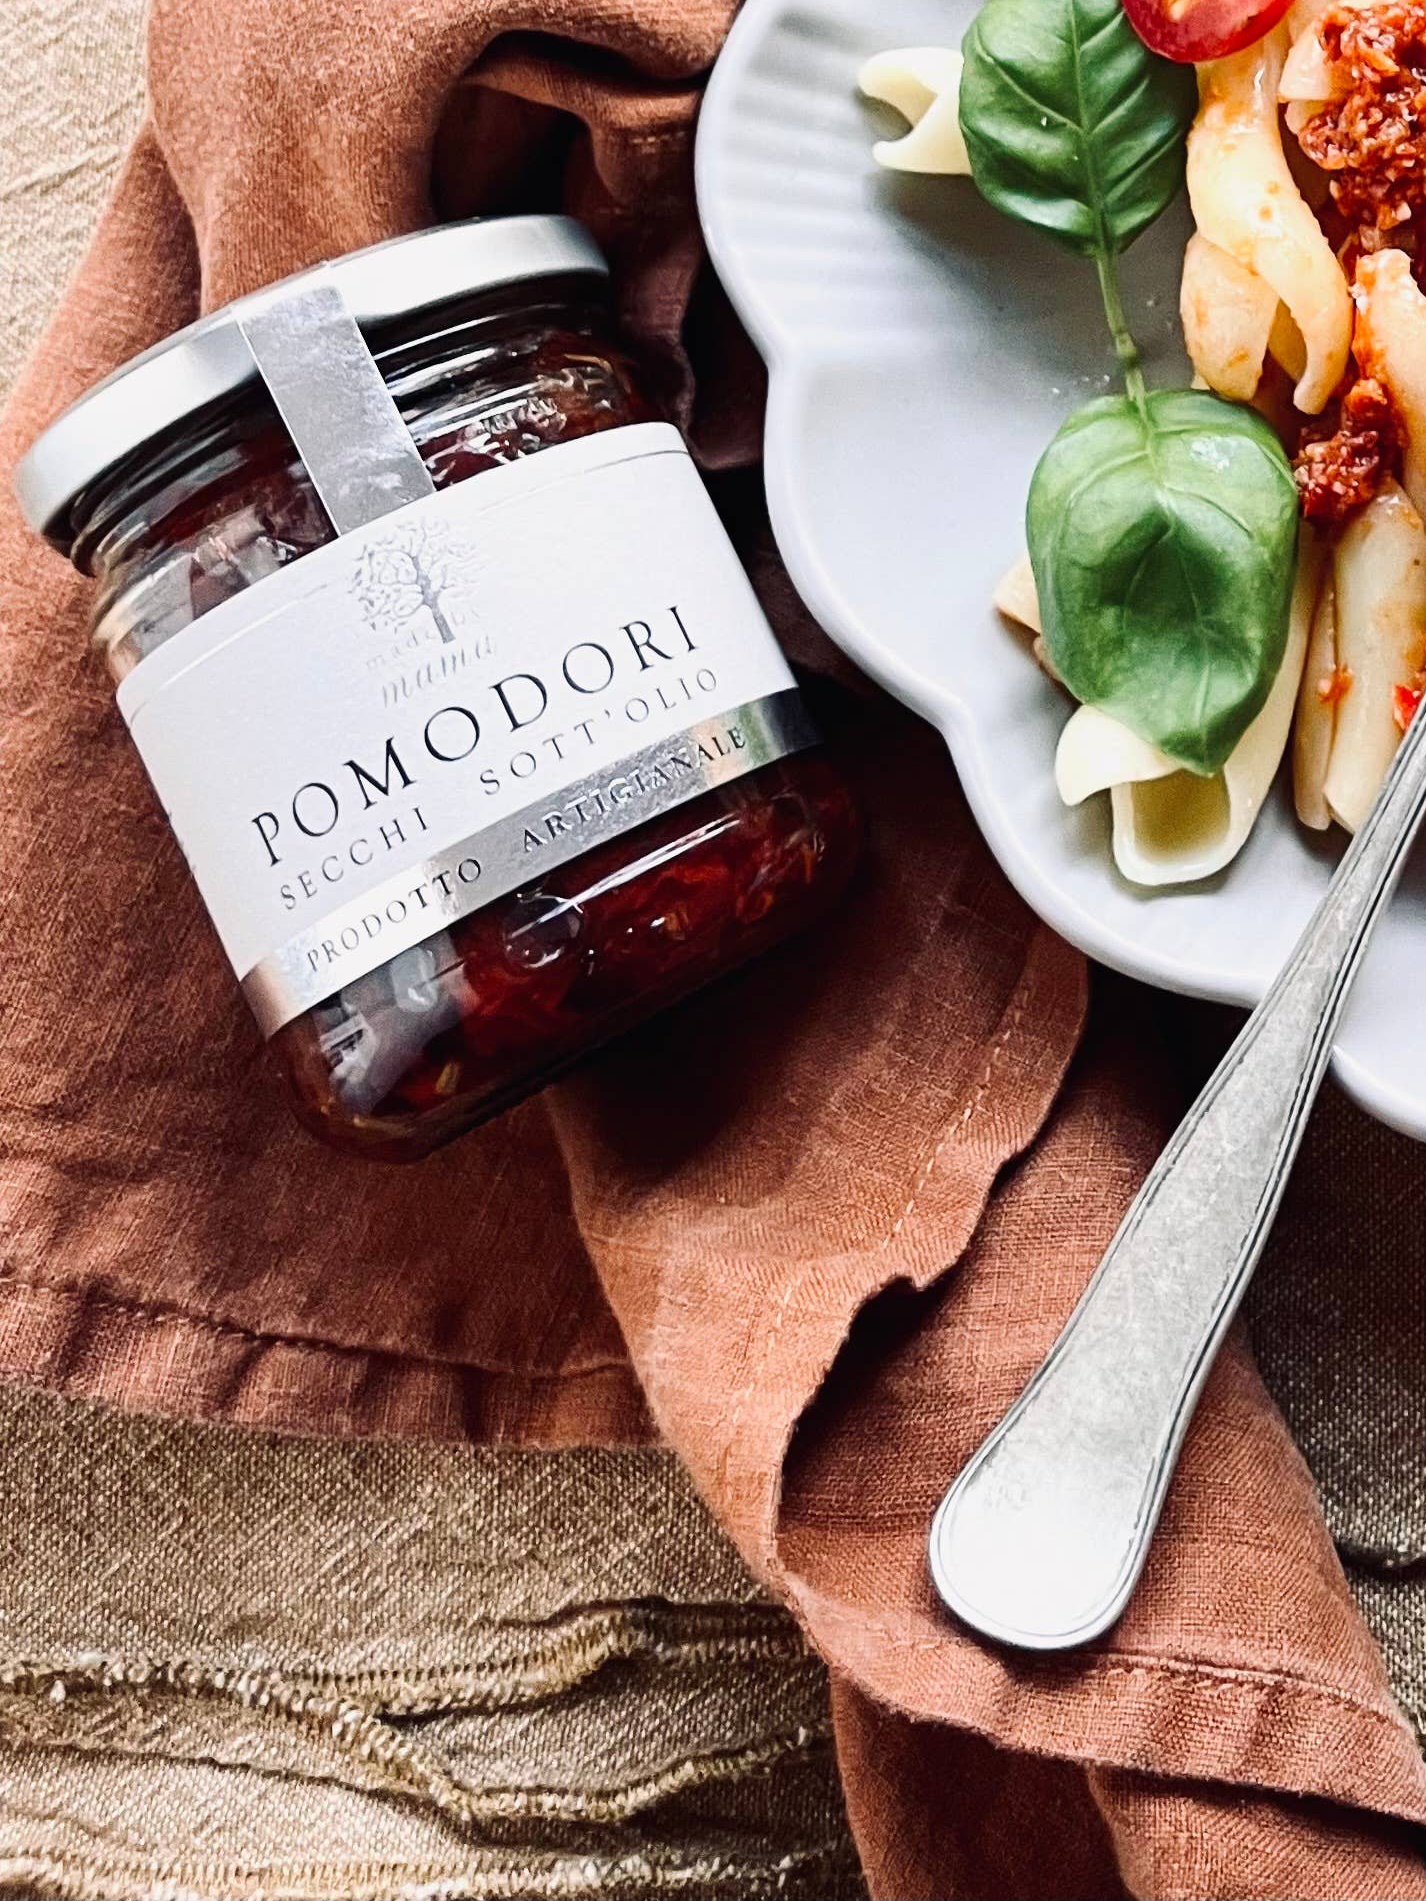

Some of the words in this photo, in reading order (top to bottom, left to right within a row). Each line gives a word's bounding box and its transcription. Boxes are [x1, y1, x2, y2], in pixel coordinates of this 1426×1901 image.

[251, 605, 699, 867] POMODORI
[280, 806, 429, 910] SECCHI
[480, 668, 717, 795] SOTT'OLIO
[381, 634, 496, 708] mama
[307, 858, 481, 973] PRODOTTO
[522, 726, 747, 853] ARTIGIANALE
